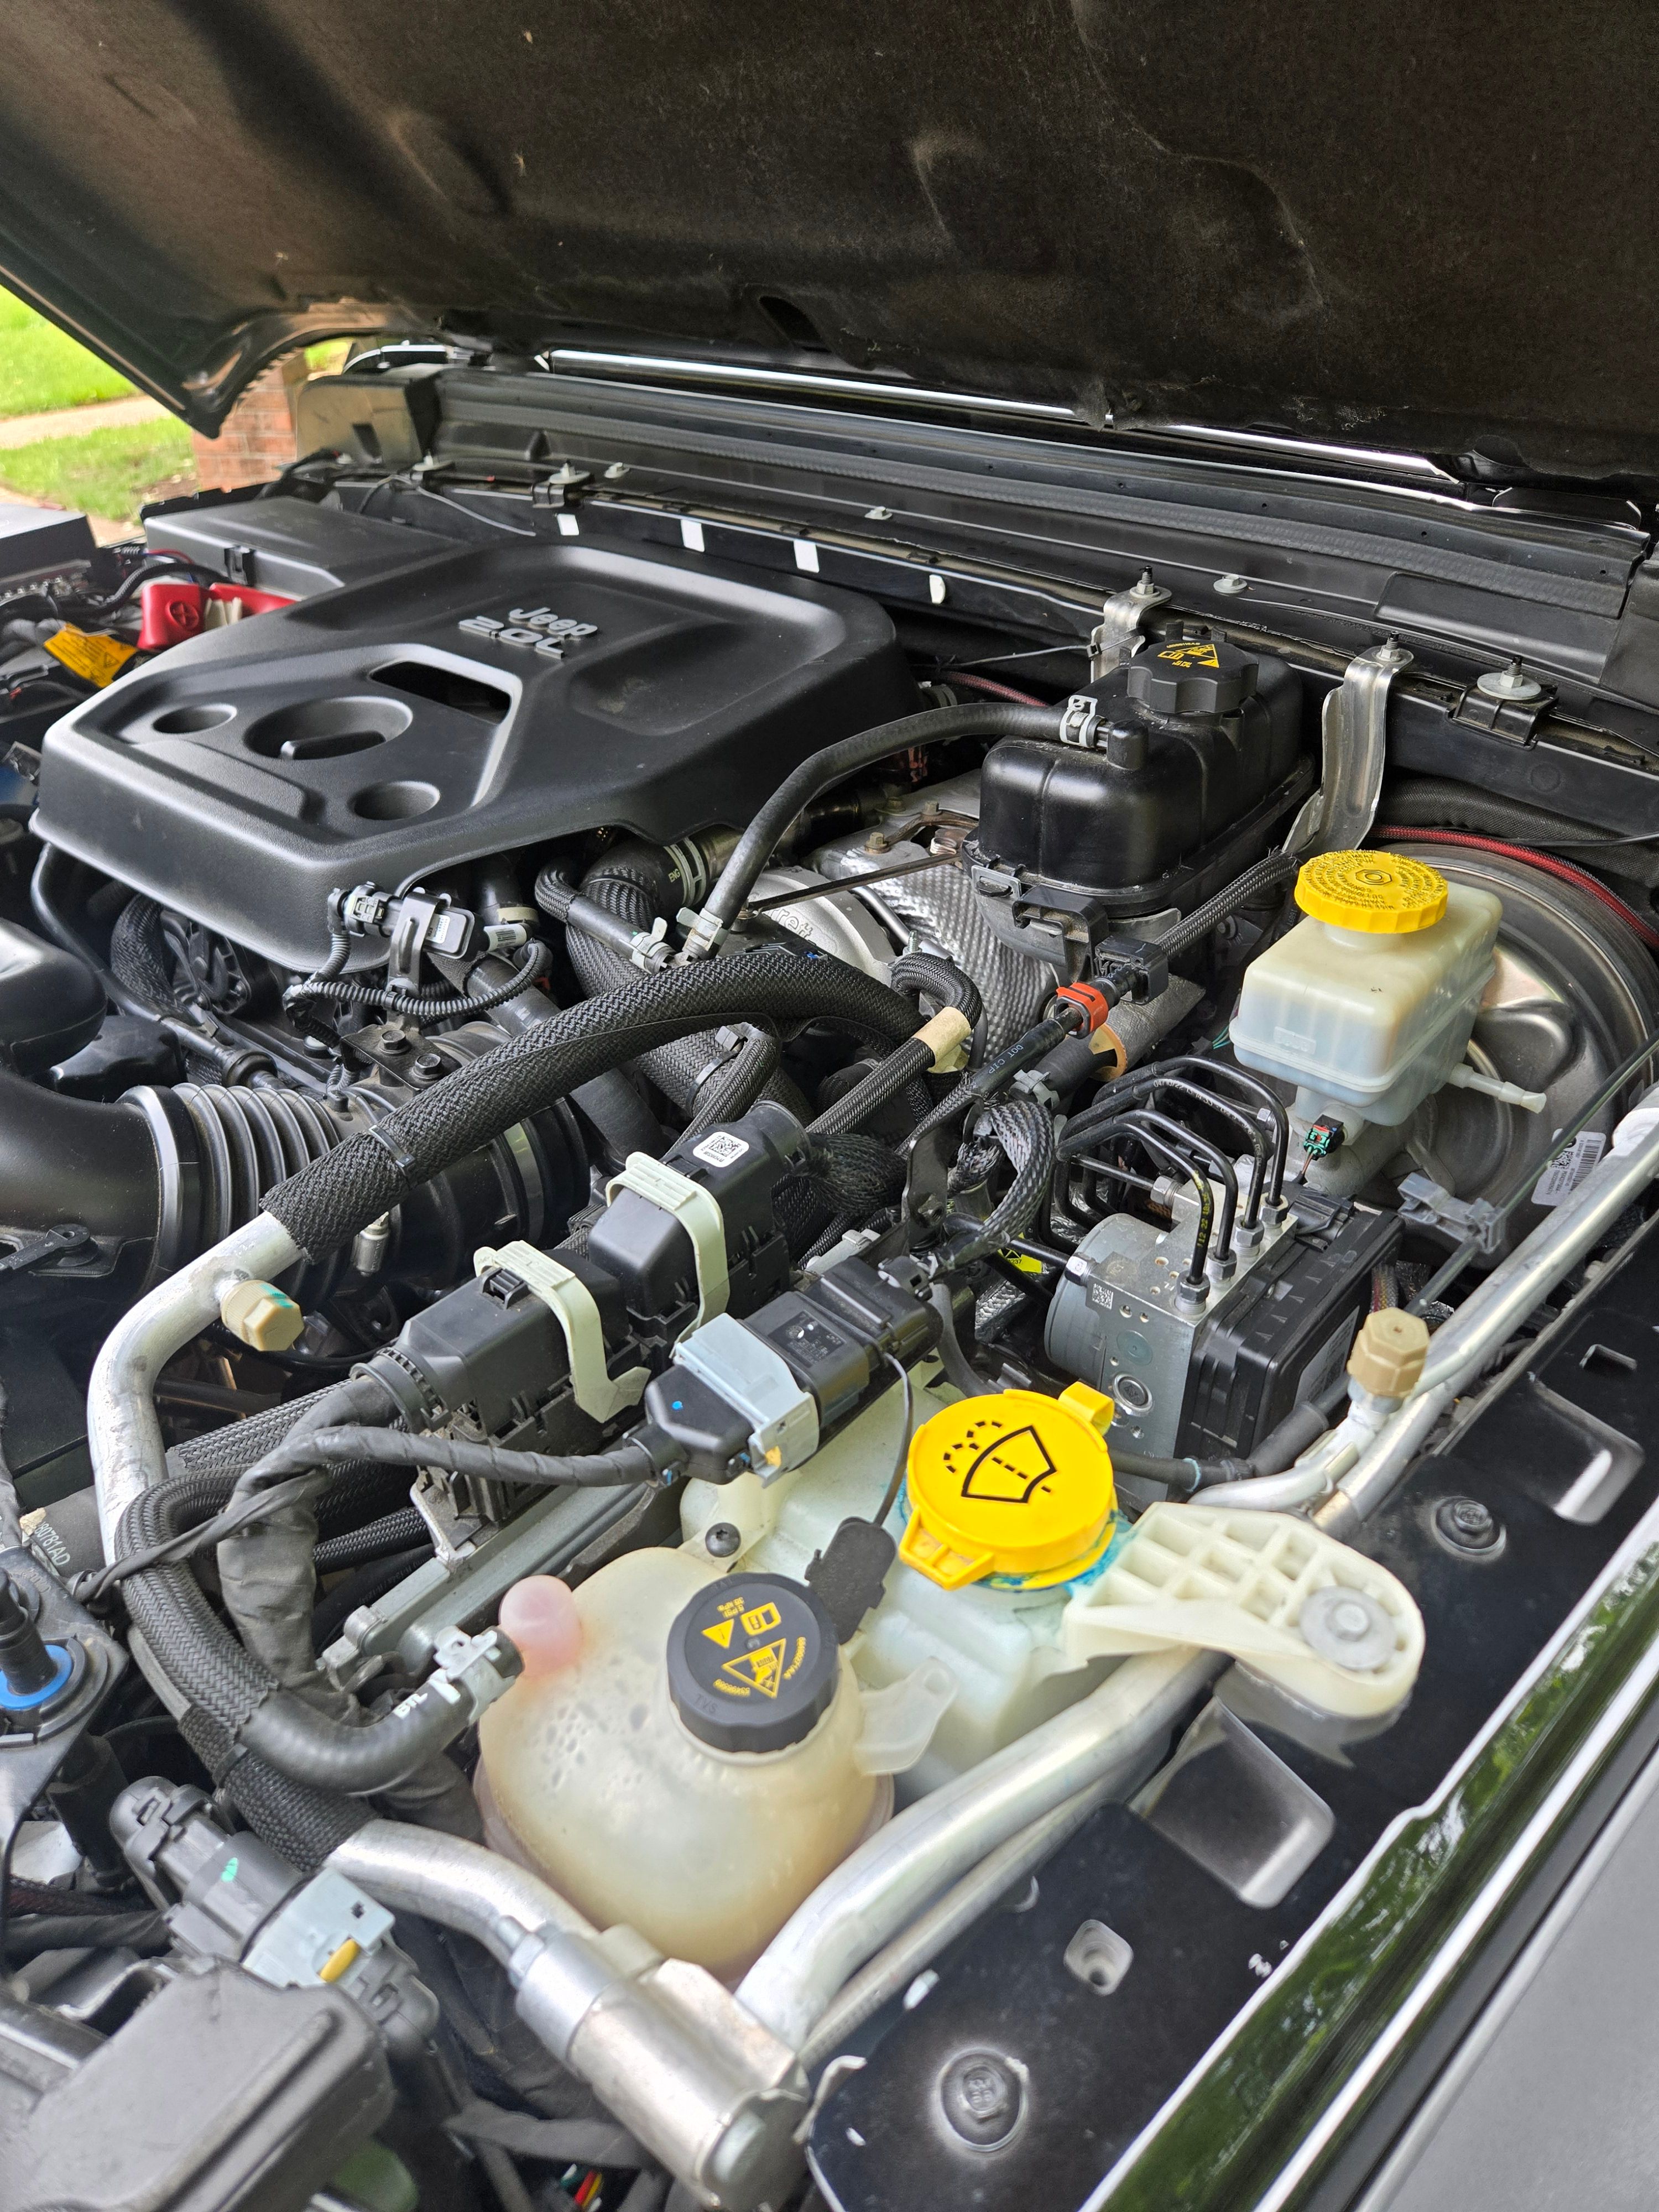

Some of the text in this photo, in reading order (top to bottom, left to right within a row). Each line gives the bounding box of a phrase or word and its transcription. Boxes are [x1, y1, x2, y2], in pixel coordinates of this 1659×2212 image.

[458, 615, 565, 660] 2.0L
[508, 607, 598, 640] Jeep
[668, 868, 681, 883] ENG
[988, 1044, 1024, 1074] DOT CIP
[33, 1521, 71, 1566] 80781AD
[694, 1694, 718, 1714] TVS
